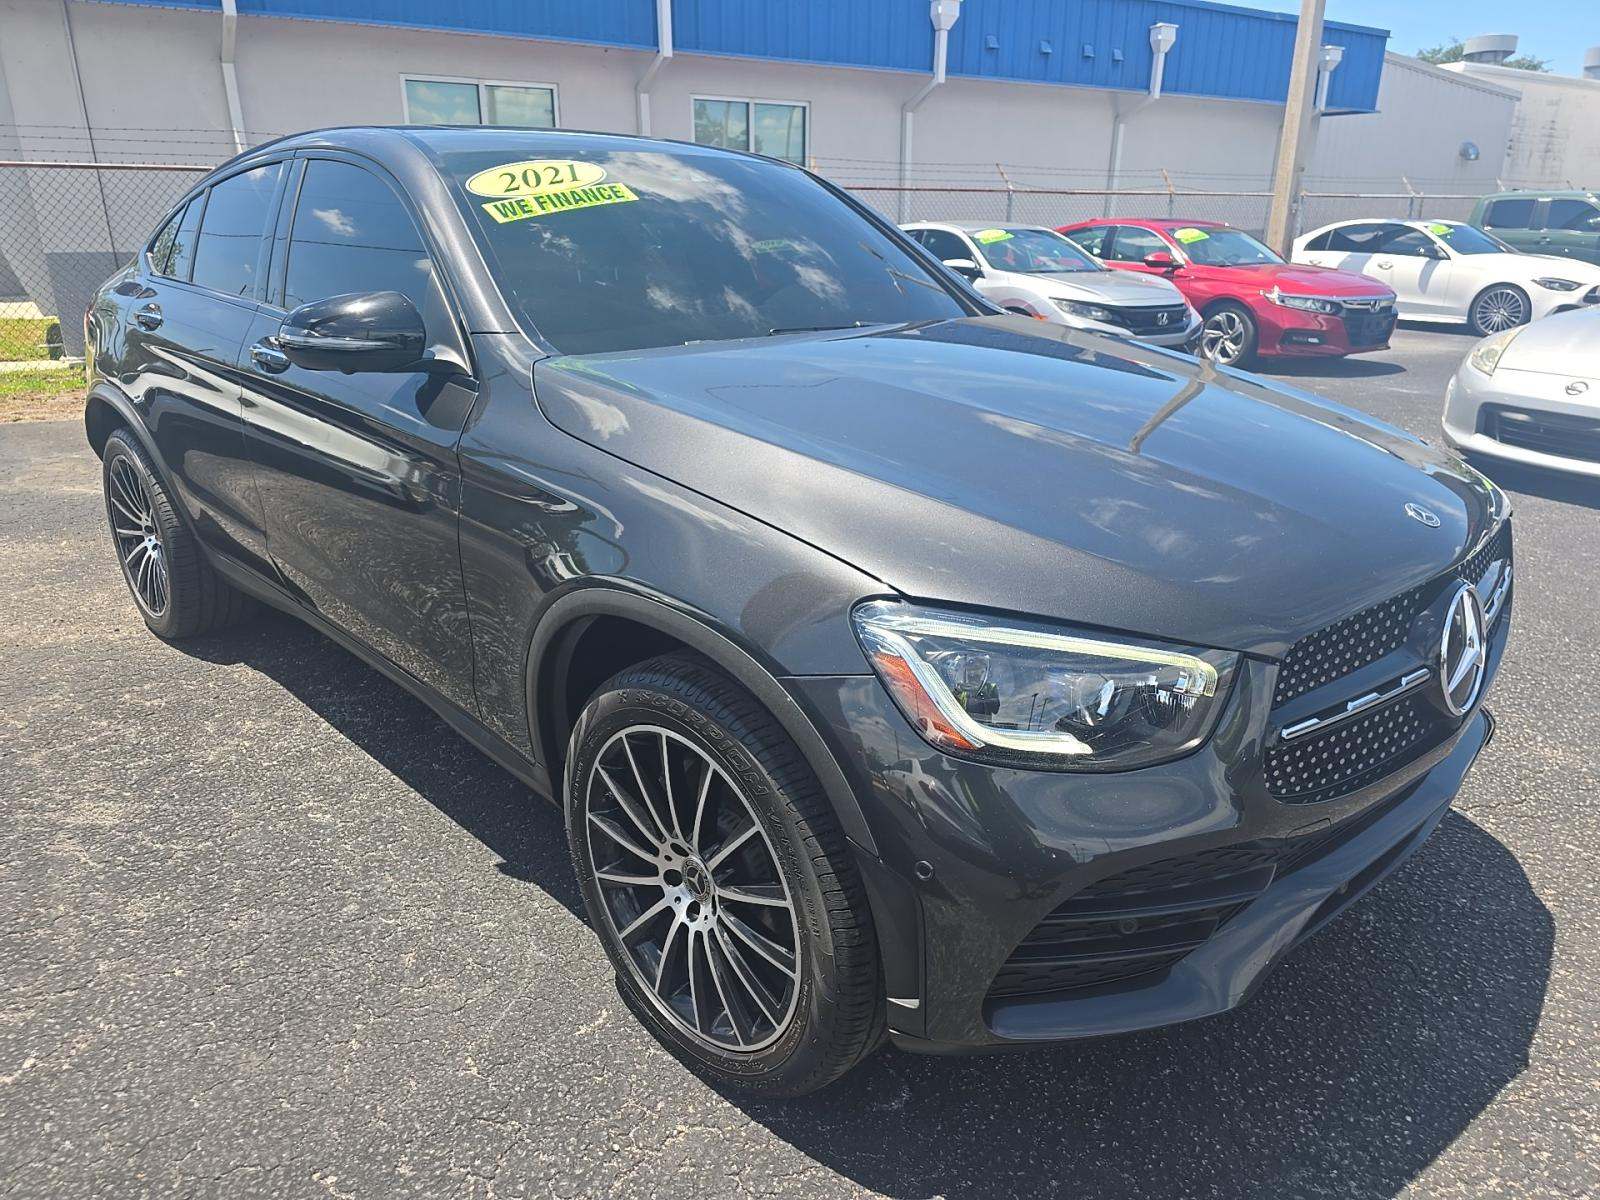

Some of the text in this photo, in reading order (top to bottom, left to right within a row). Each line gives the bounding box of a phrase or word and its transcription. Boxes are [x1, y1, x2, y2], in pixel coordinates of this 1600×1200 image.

[499, 163, 581, 193] 2021
[493, 184, 625, 219] WE FINANCE
